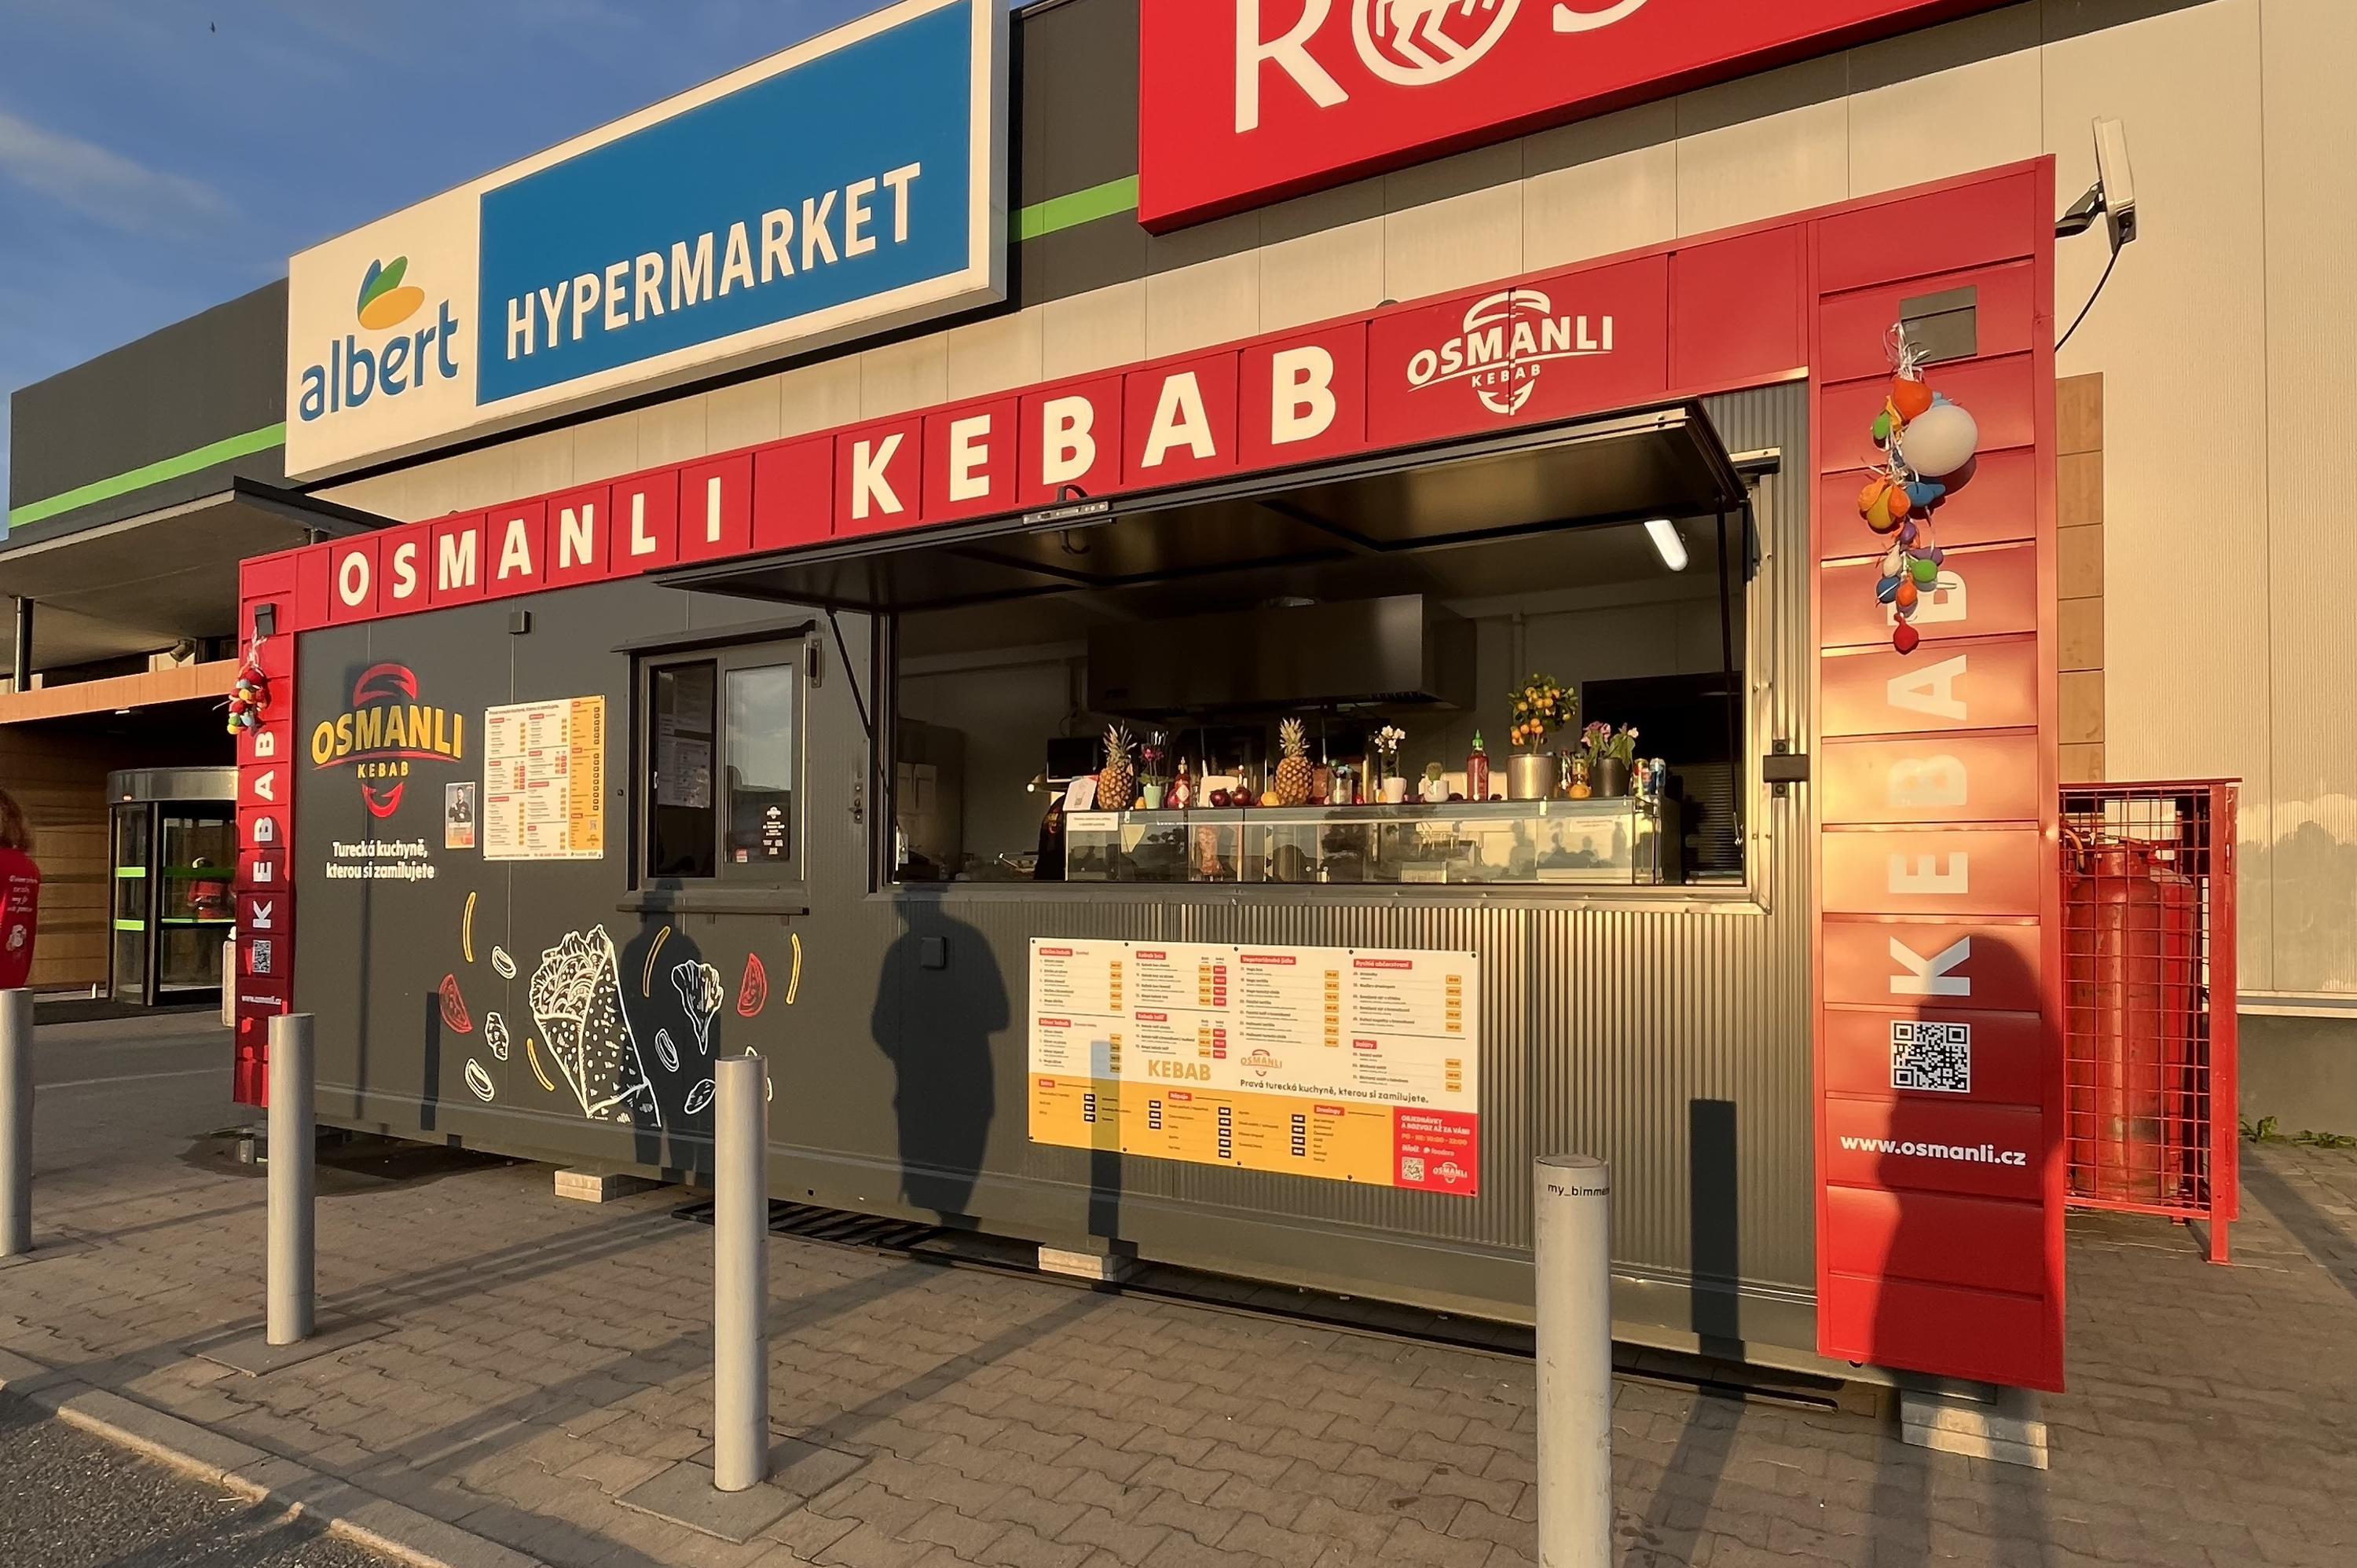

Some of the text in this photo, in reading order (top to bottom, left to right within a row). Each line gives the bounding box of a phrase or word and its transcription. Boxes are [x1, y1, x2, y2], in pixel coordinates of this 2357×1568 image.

[508, 163, 920, 359] HYPERMARKET
[299, 299, 459, 422] albert
[1407, 316, 1612, 386] OSMANLI
[1472, 365, 1540, 387] KEBAB
[339, 346, 1335, 606] OSMANLI KEBAB
[312, 705, 462, 765] OSMANLI
[357, 761, 409, 779] KEBAB
[253, 731, 274, 928] KEBAB
[333, 838, 427, 859] Turecká kuchyně,
[327, 860, 434, 881] kterou si zamilujete
[1148, 1060, 1211, 1081] KEBAB
[1241, 1054, 1282, 1069] OSMANLI
[1241, 1079, 1429, 1104] Pravá turecká kuchyně, kterou si zamilujete.
[1839, 1136, 2026, 1166] www.osmanli.cz
[1432, 1167, 1468, 1178] OSMANLI
